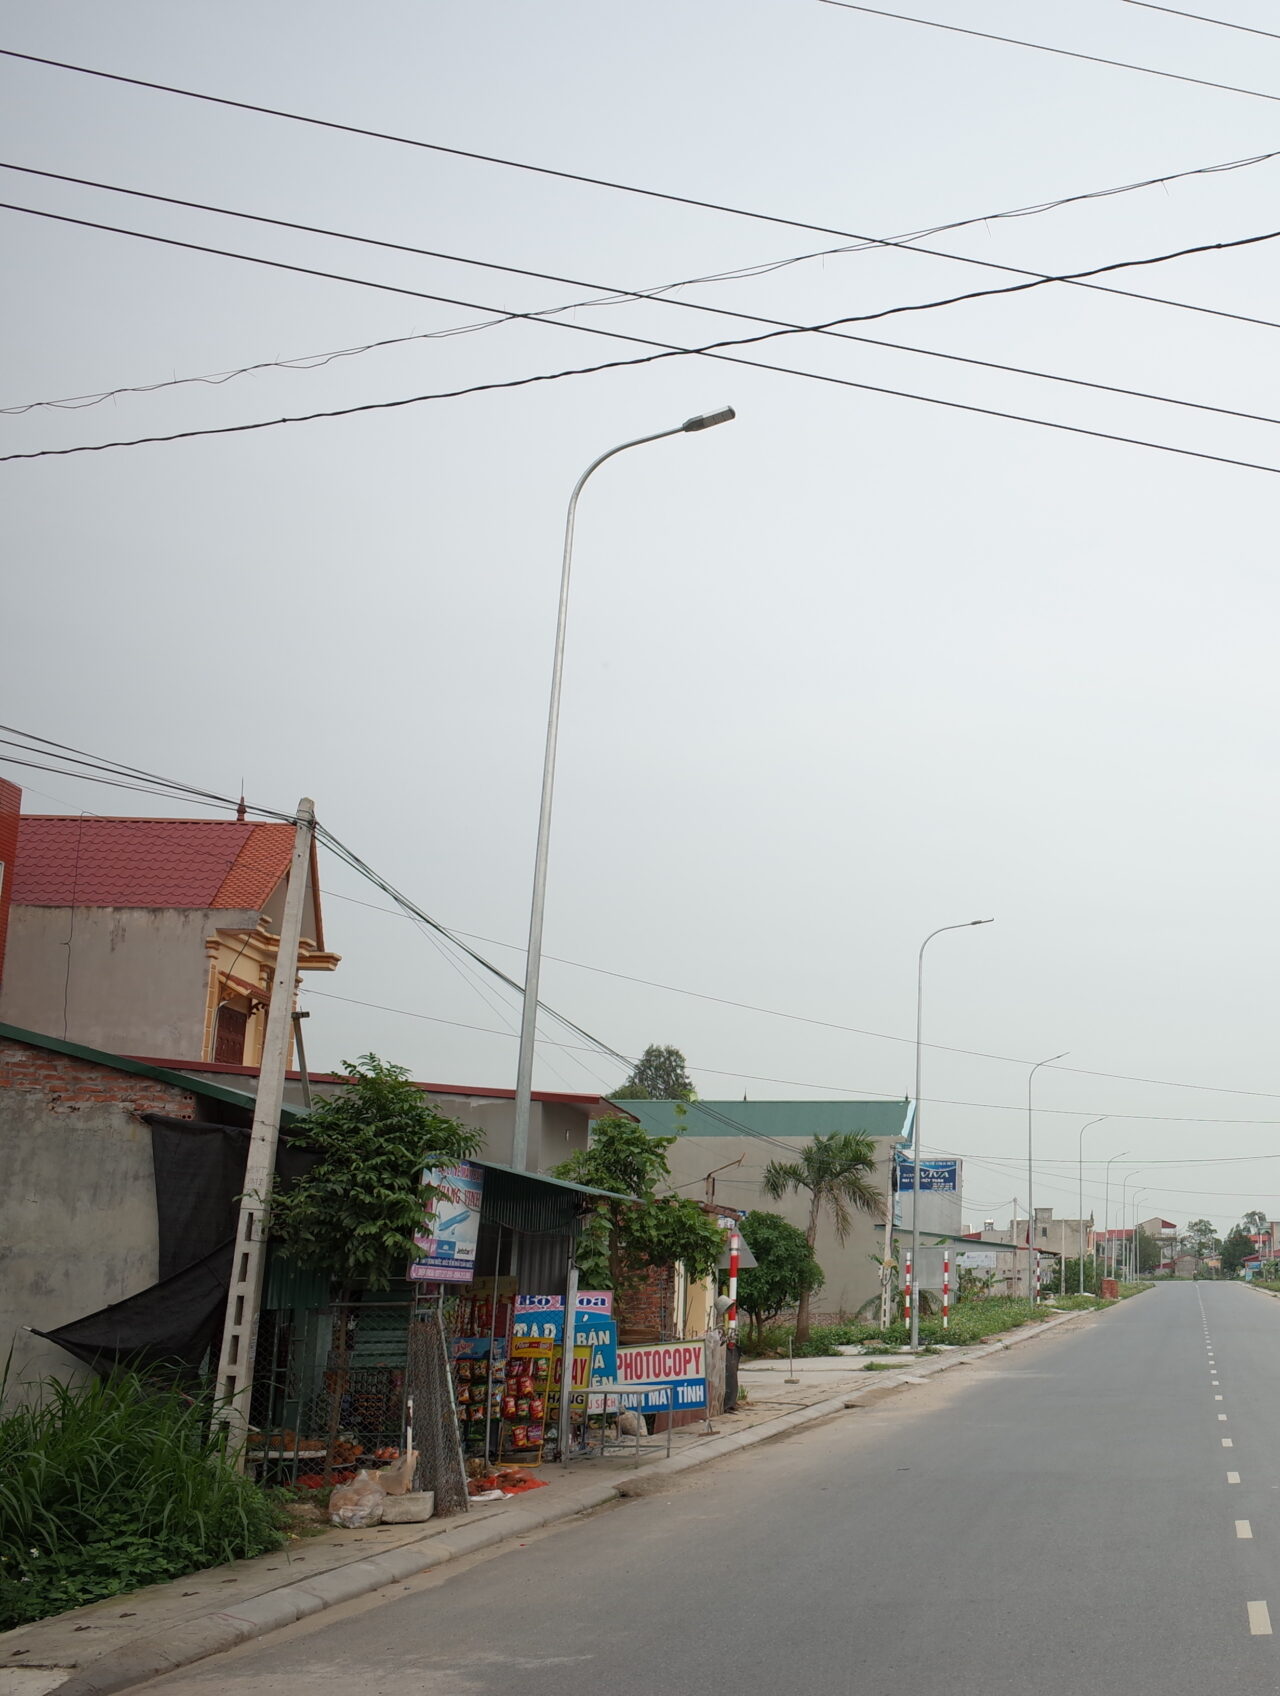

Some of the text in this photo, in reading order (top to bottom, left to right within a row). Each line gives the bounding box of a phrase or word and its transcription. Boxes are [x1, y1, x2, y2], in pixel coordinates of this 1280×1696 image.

[577, 1328, 610, 1345] BÁN
[617, 1347, 701, 1381] PHOTOCOPY
[677, 1383, 704, 1403] TÍNH
